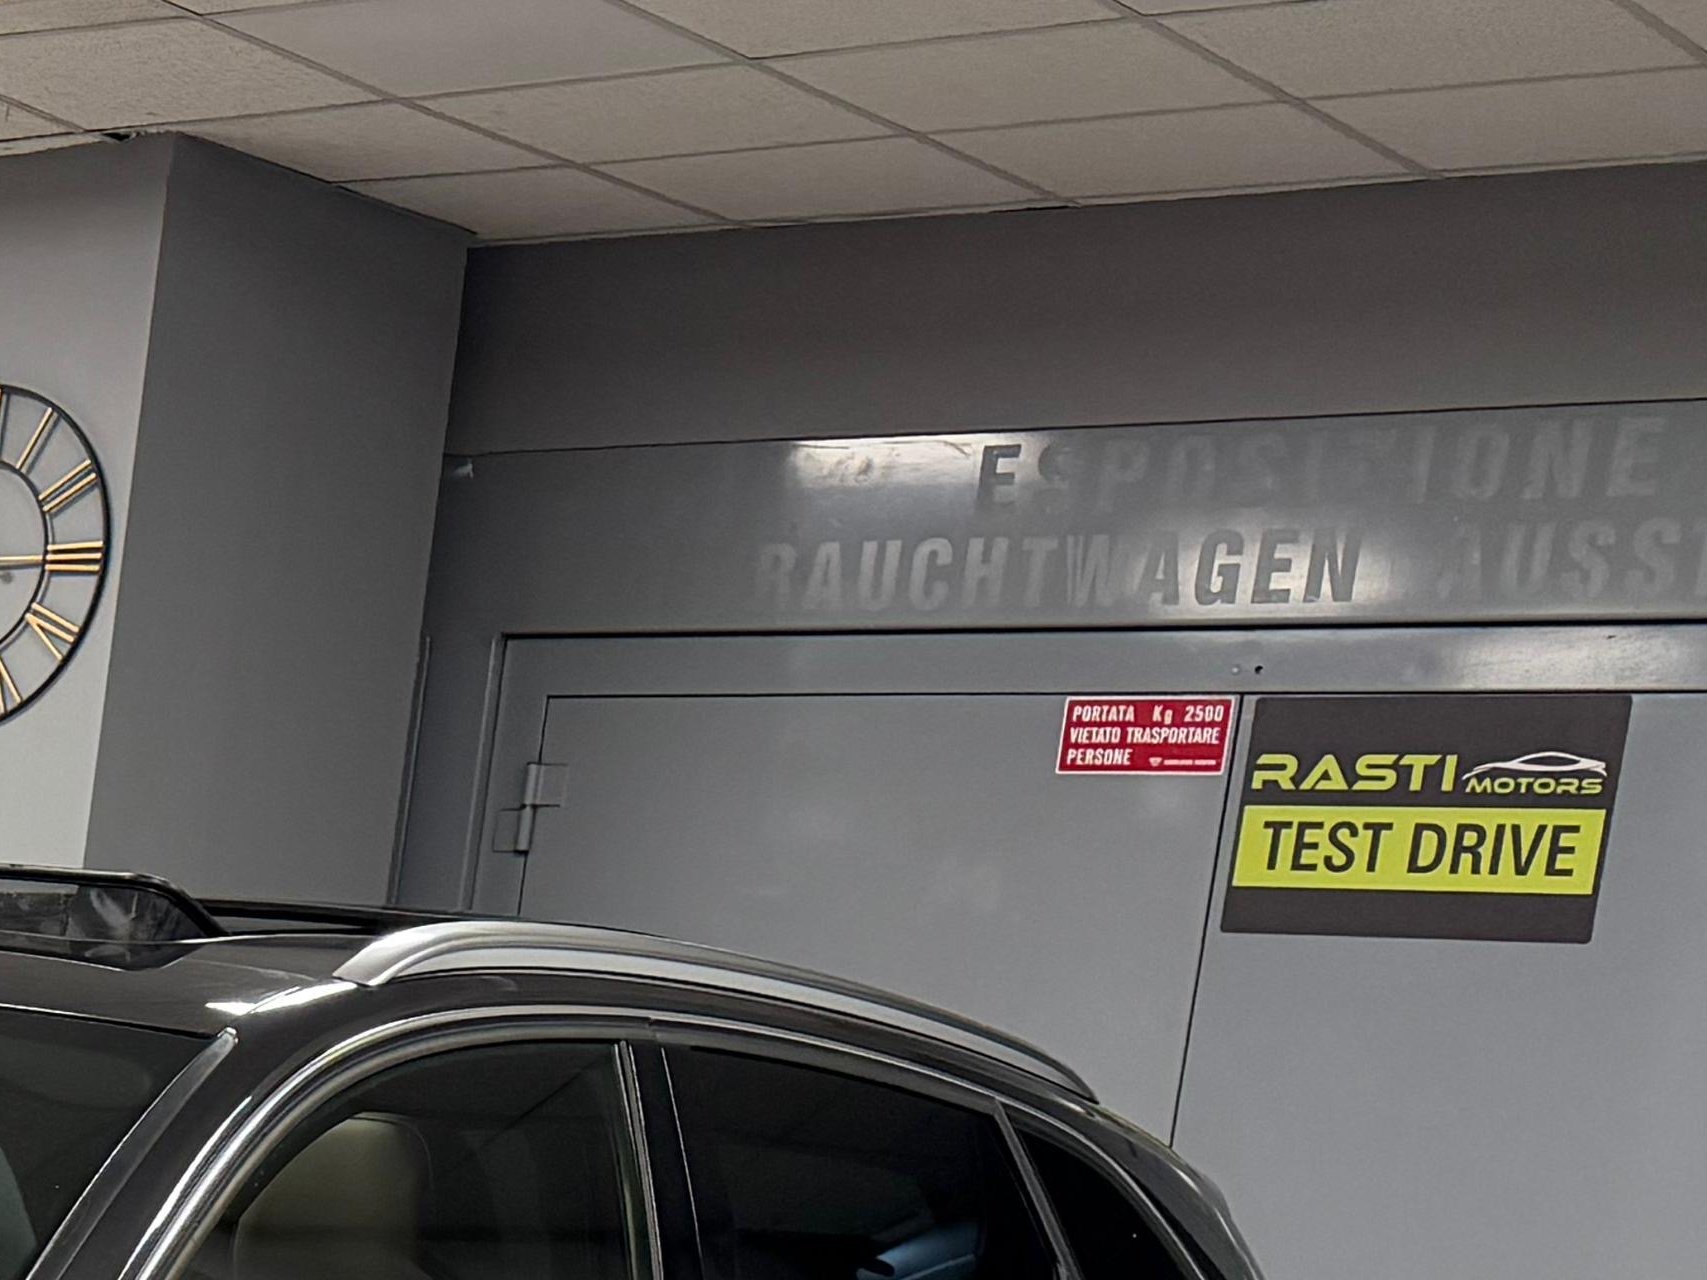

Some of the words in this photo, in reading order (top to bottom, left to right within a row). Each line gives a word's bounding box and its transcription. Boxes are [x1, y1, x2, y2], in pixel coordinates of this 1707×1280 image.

[1072, 705, 1135, 722] PORTATA
[1152, 705, 1173, 725] Kg
[1184, 705, 1224, 722] 2500
[1070, 727, 1121, 744] VIETATO
[1126, 727, 1221, 745] TRASPORTARE
[1067, 748, 1133, 765] PERSONE
[1251, 753, 1459, 793] RASTI
[1464, 777, 1603, 795] MOTORS
[1262, 820, 1394, 873] TEST
[1406, 823, 1581, 877] DRIVE
